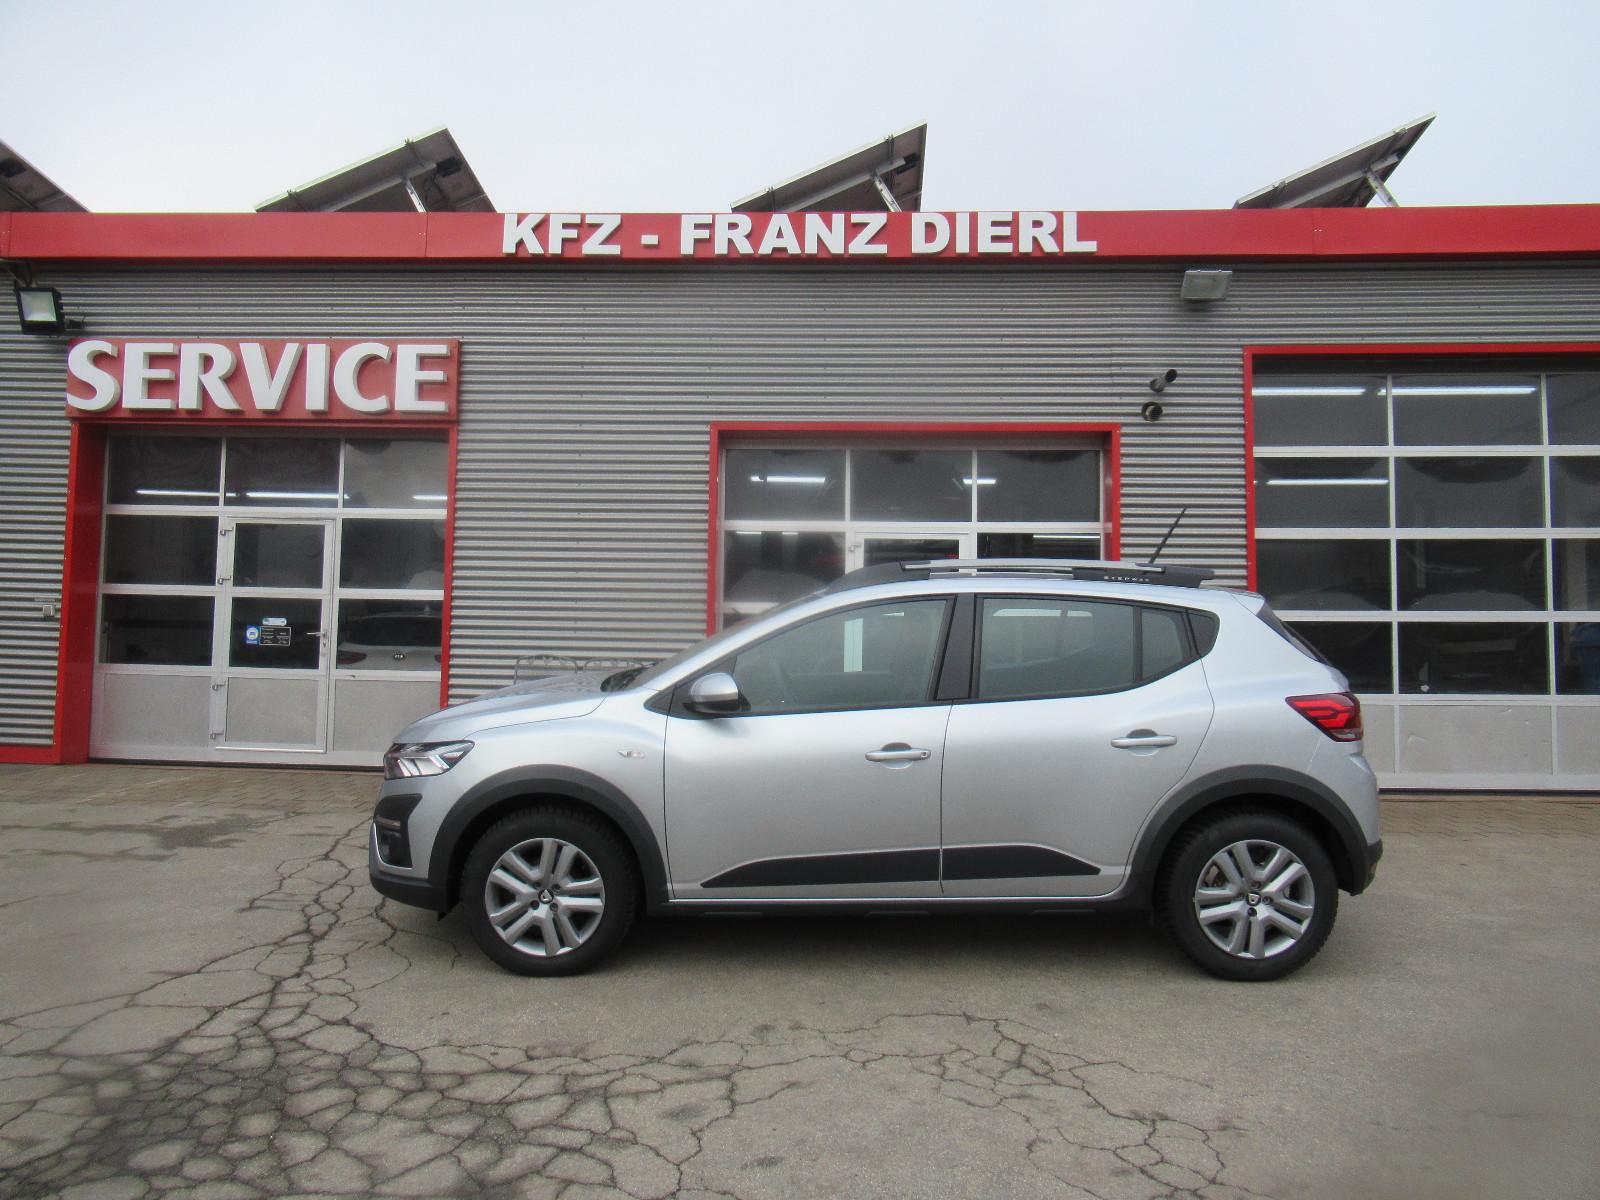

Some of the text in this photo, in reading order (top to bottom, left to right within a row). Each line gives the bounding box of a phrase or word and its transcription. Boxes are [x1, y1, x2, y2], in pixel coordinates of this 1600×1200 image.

[501, 213, 622, 255] KFZ
[680, 213, 888, 255] FRANZ
[911, 211, 1098, 253] DIERL
[66, 340, 450, 414] SERVICE
